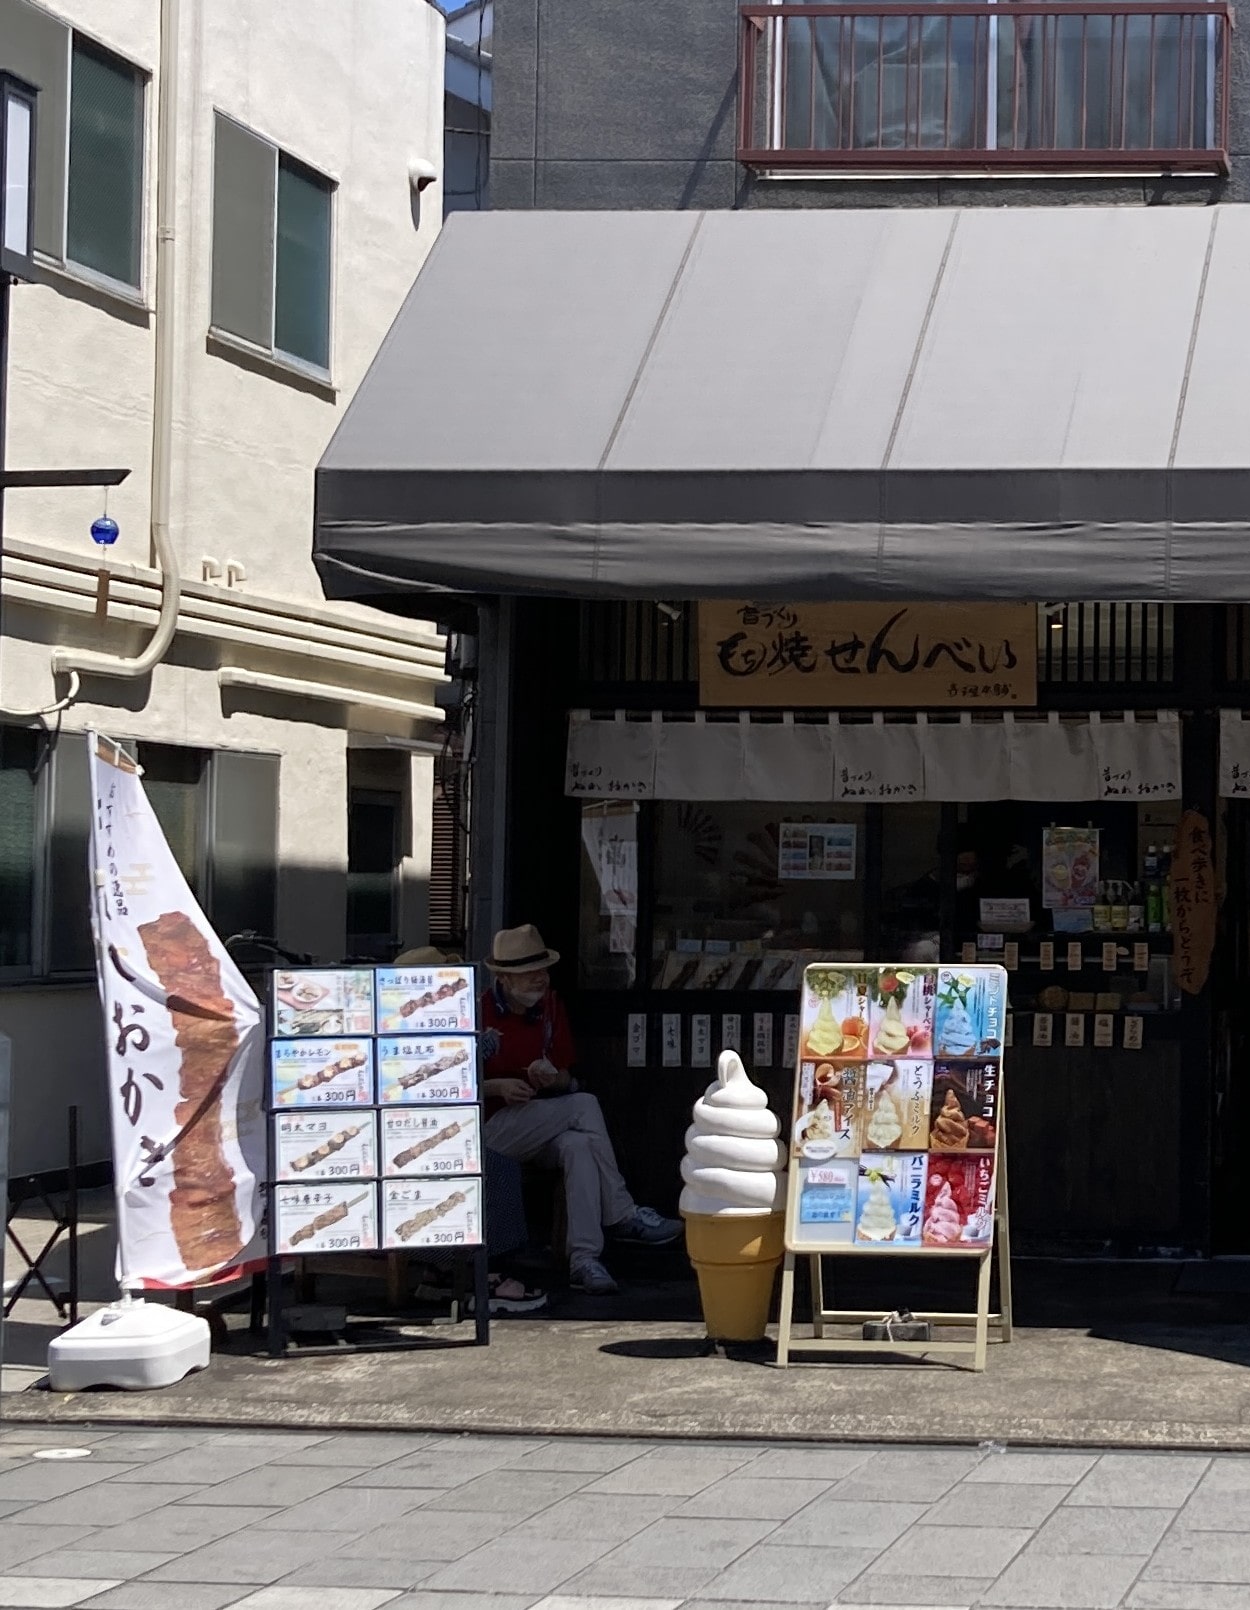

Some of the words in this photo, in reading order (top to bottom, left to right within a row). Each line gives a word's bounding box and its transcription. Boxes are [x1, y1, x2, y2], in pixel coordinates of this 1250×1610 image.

[737, 606, 798, 629] 昔づくり
[427, 1017, 458, 1029] 300円
[325, 1089, 356, 1101] 300円
[429, 1086, 459, 1098] 300円
[983, 1065, 996, 1117] 生チョコ
[281, 1122, 327, 1132] 明太マヨ
[328, 1164, 360, 1175] 300円
[433, 1159, 464, 1171] 300円
[910, 1155, 924, 1226] バニラミルク
[976, 1158, 991, 1230] いちごミルク
[328, 1235, 361, 1248] 300円
[434, 1232, 465, 1243] 300円
